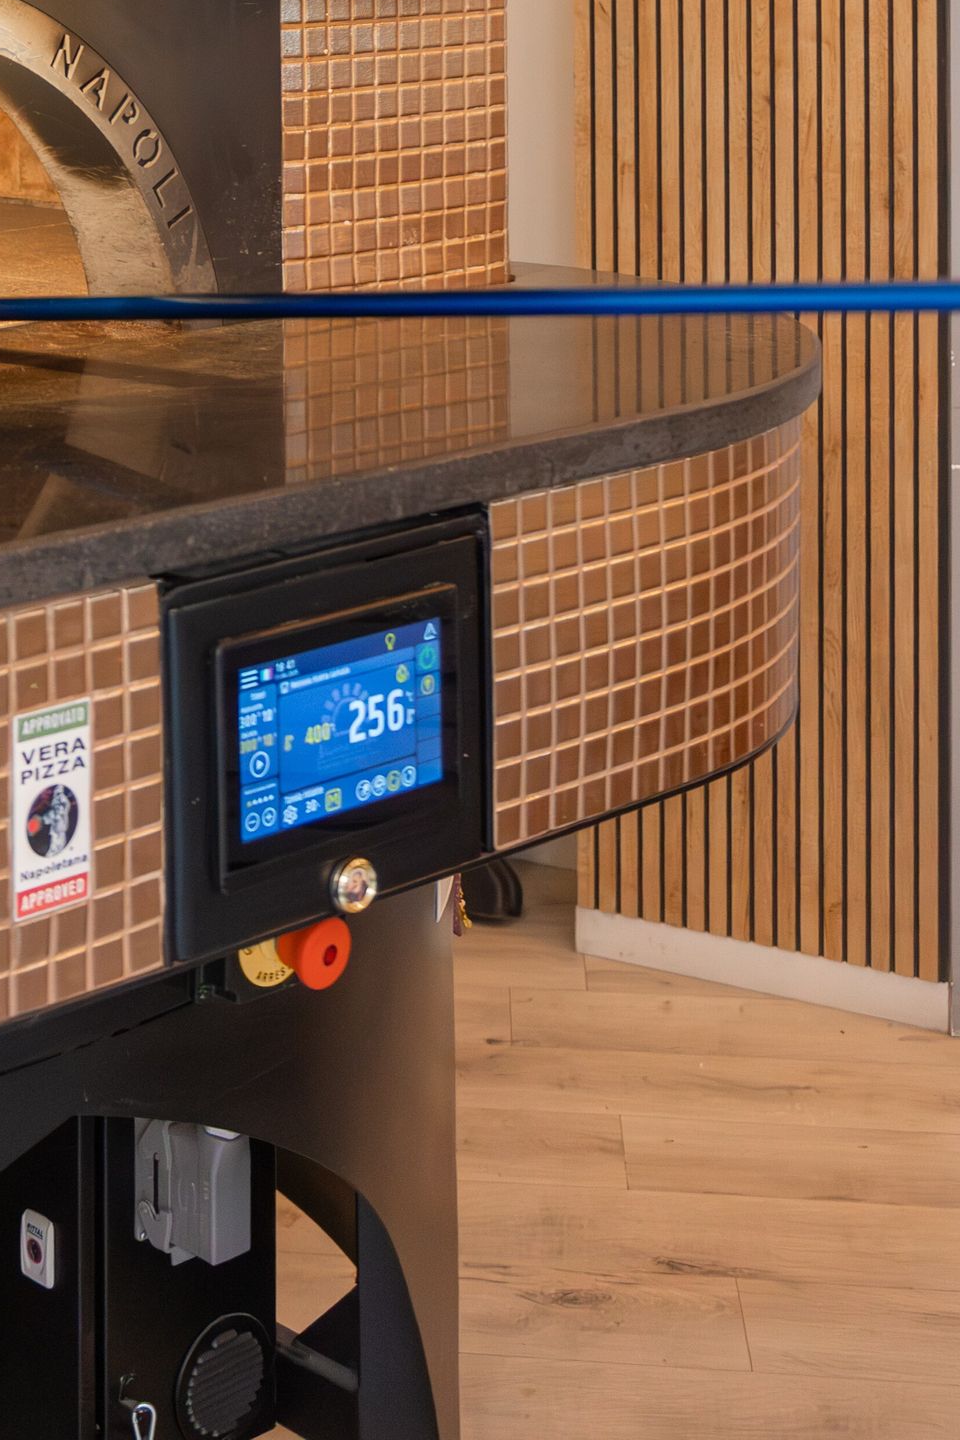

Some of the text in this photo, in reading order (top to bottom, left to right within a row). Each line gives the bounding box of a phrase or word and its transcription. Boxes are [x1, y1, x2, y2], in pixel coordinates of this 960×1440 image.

[51, 33, 194, 230] NAPOLI
[22, 706, 86, 736] APPROVATO
[22, 737, 86, 765] VERA
[20, 756, 86, 785] PIZZA
[20, 877, 86, 913] APPROVED
